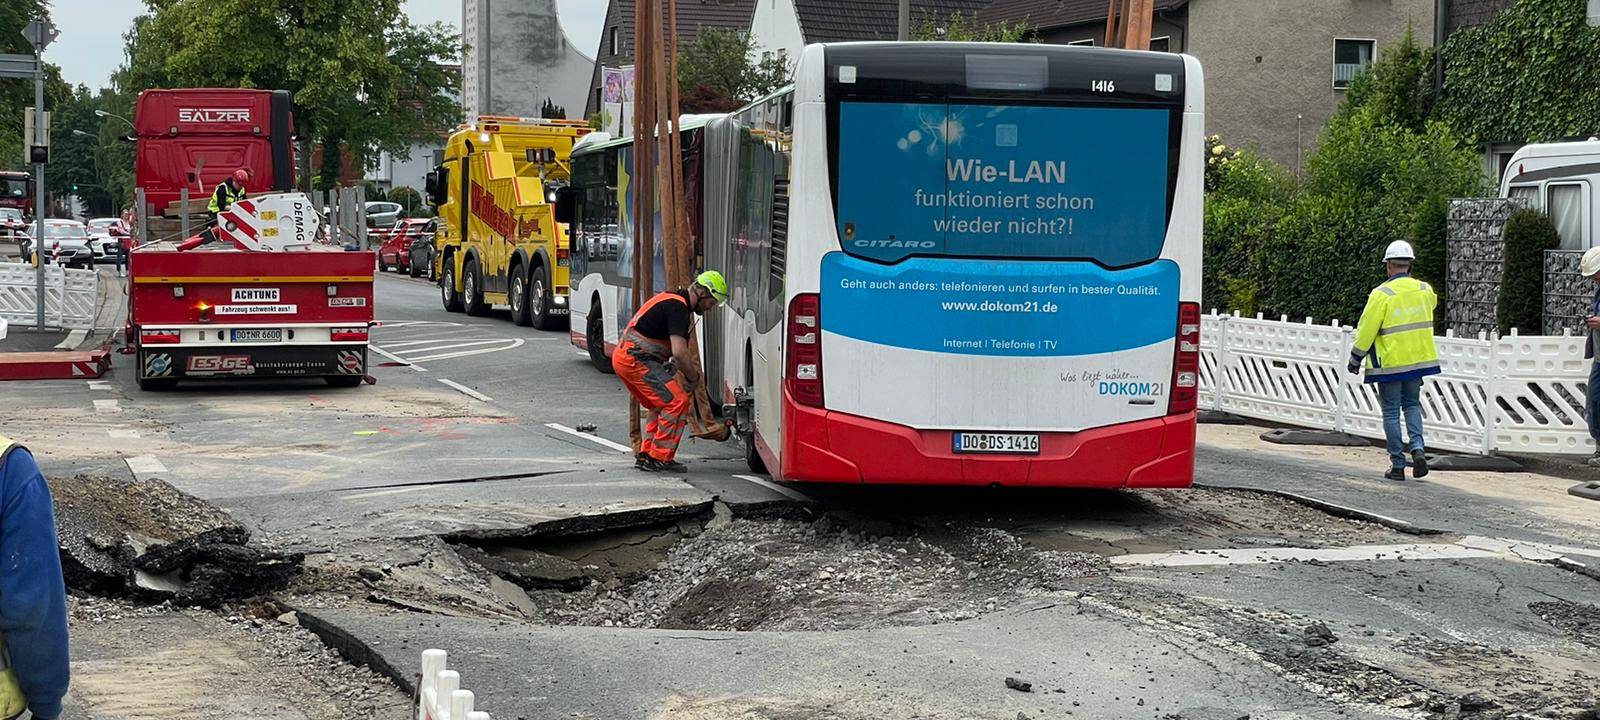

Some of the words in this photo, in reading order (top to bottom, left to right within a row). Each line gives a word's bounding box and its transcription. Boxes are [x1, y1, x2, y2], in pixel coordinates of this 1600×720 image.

[1092, 80, 1115, 93] 1416
[179, 108, 250, 122] SÄLZER
[946, 159, 1067, 184] Wie-LAN
[914, 190, 1029, 209] funktioniert
[1036, 193, 1094, 210] schon
[293, 202, 305, 241] DEMAG
[933, 215, 1001, 233] wieder
[1008, 216, 1073, 235] nicht?!
[854, 240, 936, 249] CITARO
[234, 290, 278, 300] ACHTUNG
[840, 279, 867, 291] Geht
[869, 280, 896, 291] auch
[898, 280, 938, 292] anders:
[941, 281, 1005, 293] telefonieren
[1008, 282, 1029, 293] und
[1031, 282, 1065, 294] surfen
[1067, 283, 1079, 294] in
[1081, 284, 1114, 295] bester
[1116, 284, 1161, 297] Qualität.
[222, 306, 248, 314] Fahrzeug
[941, 299, 1058, 314] www.dokom21.de
[943, 339, 982, 349] Internet
[990, 339, 1036, 350] Telefonie
[1043, 340, 1058, 350] TV
[1082, 371, 1101, 387] liegt
[1099, 382, 1164, 396] DOKOM21
[963, 434, 978, 448] DO
